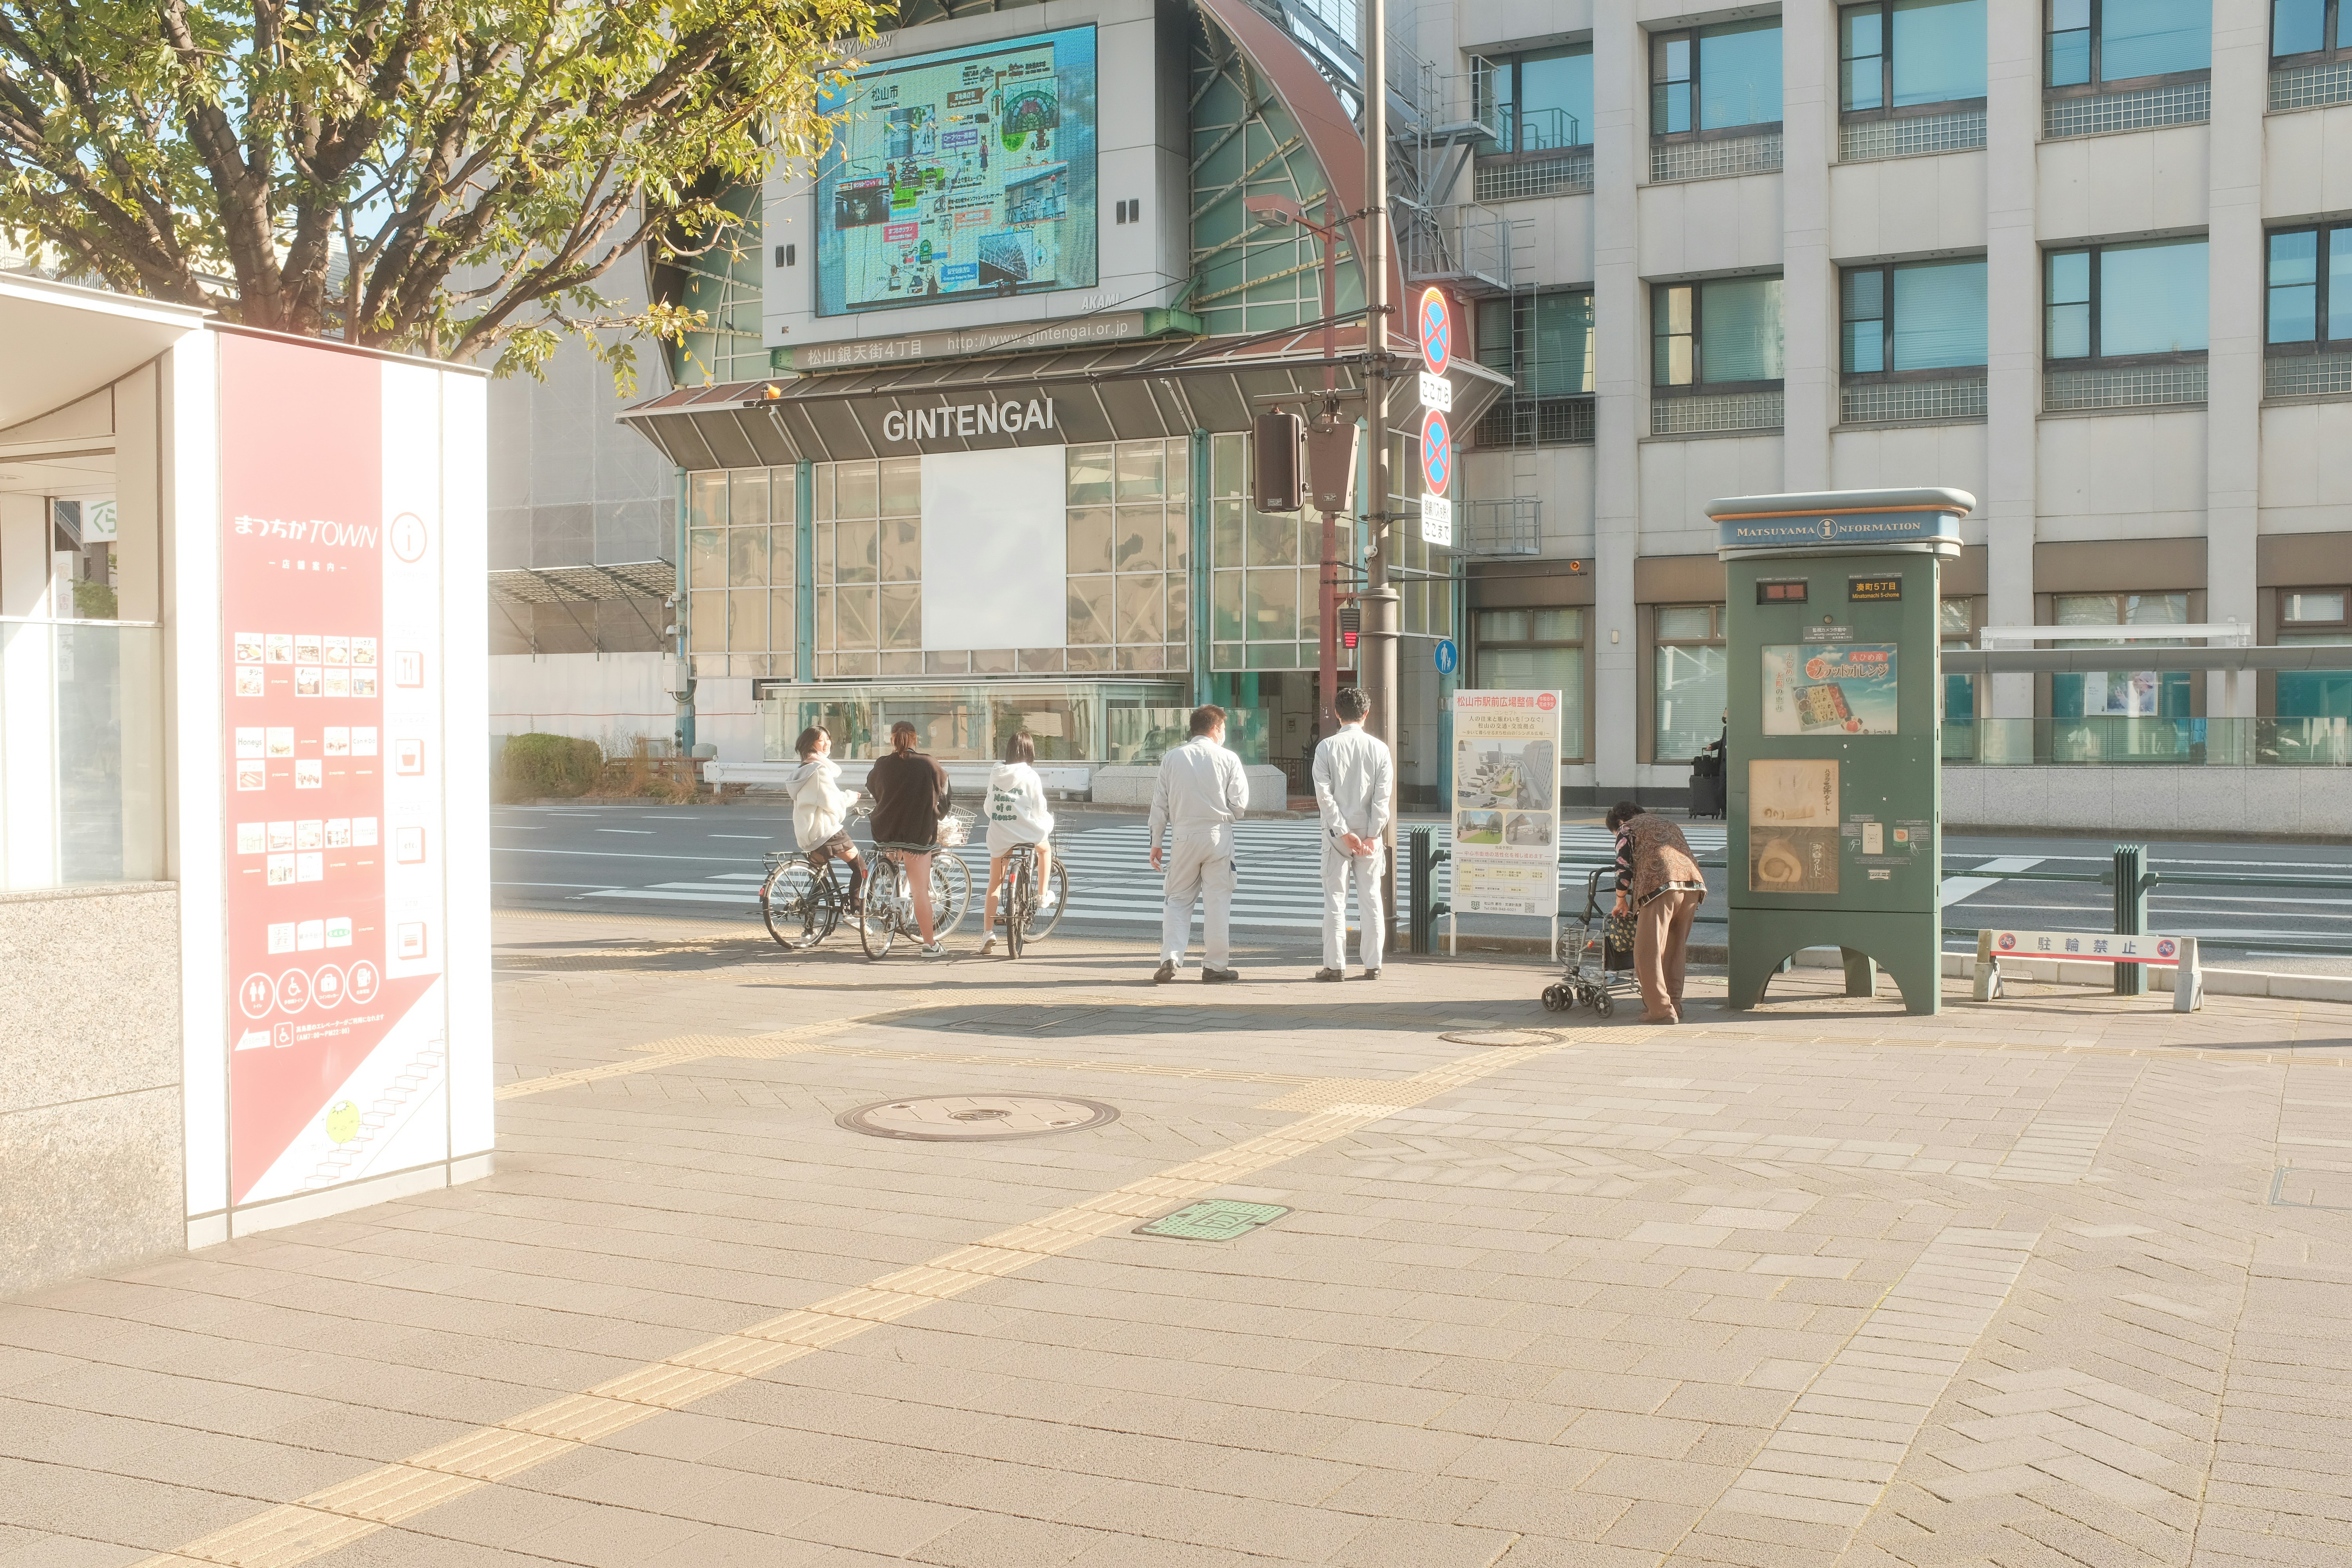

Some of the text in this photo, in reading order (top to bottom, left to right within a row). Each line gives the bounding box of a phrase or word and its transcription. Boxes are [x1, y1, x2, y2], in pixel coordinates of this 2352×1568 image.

[871, 85, 898, 102] 松山市
[1082, 293, 1120, 310] AKAMI
[808, 321, 1129, 365] 松山銀天街4丁目 http://www.gintengai.or.jp
[1423, 381, 1449, 404] ここから
[883, 397, 1053, 442] GINTENGAI
[235, 515, 378, 549] まつちかTOWN
[1425, 521, 1449, 540] ここまで
[1737, 526, 1815, 537] MATSUYAMA
[1856, 582, 1896, 592] 湊町5丁目
[1812, 663, 1889, 678] ブラッドオレンジ
[1457, 696, 1534, 708] 松山市駅前広場整備
[238, 738, 262, 748] Honeys
[994, 794, 1016, 802] Make
[996, 803, 1004, 812] of
[2037, 936, 2136, 955] 駐輪禁止
